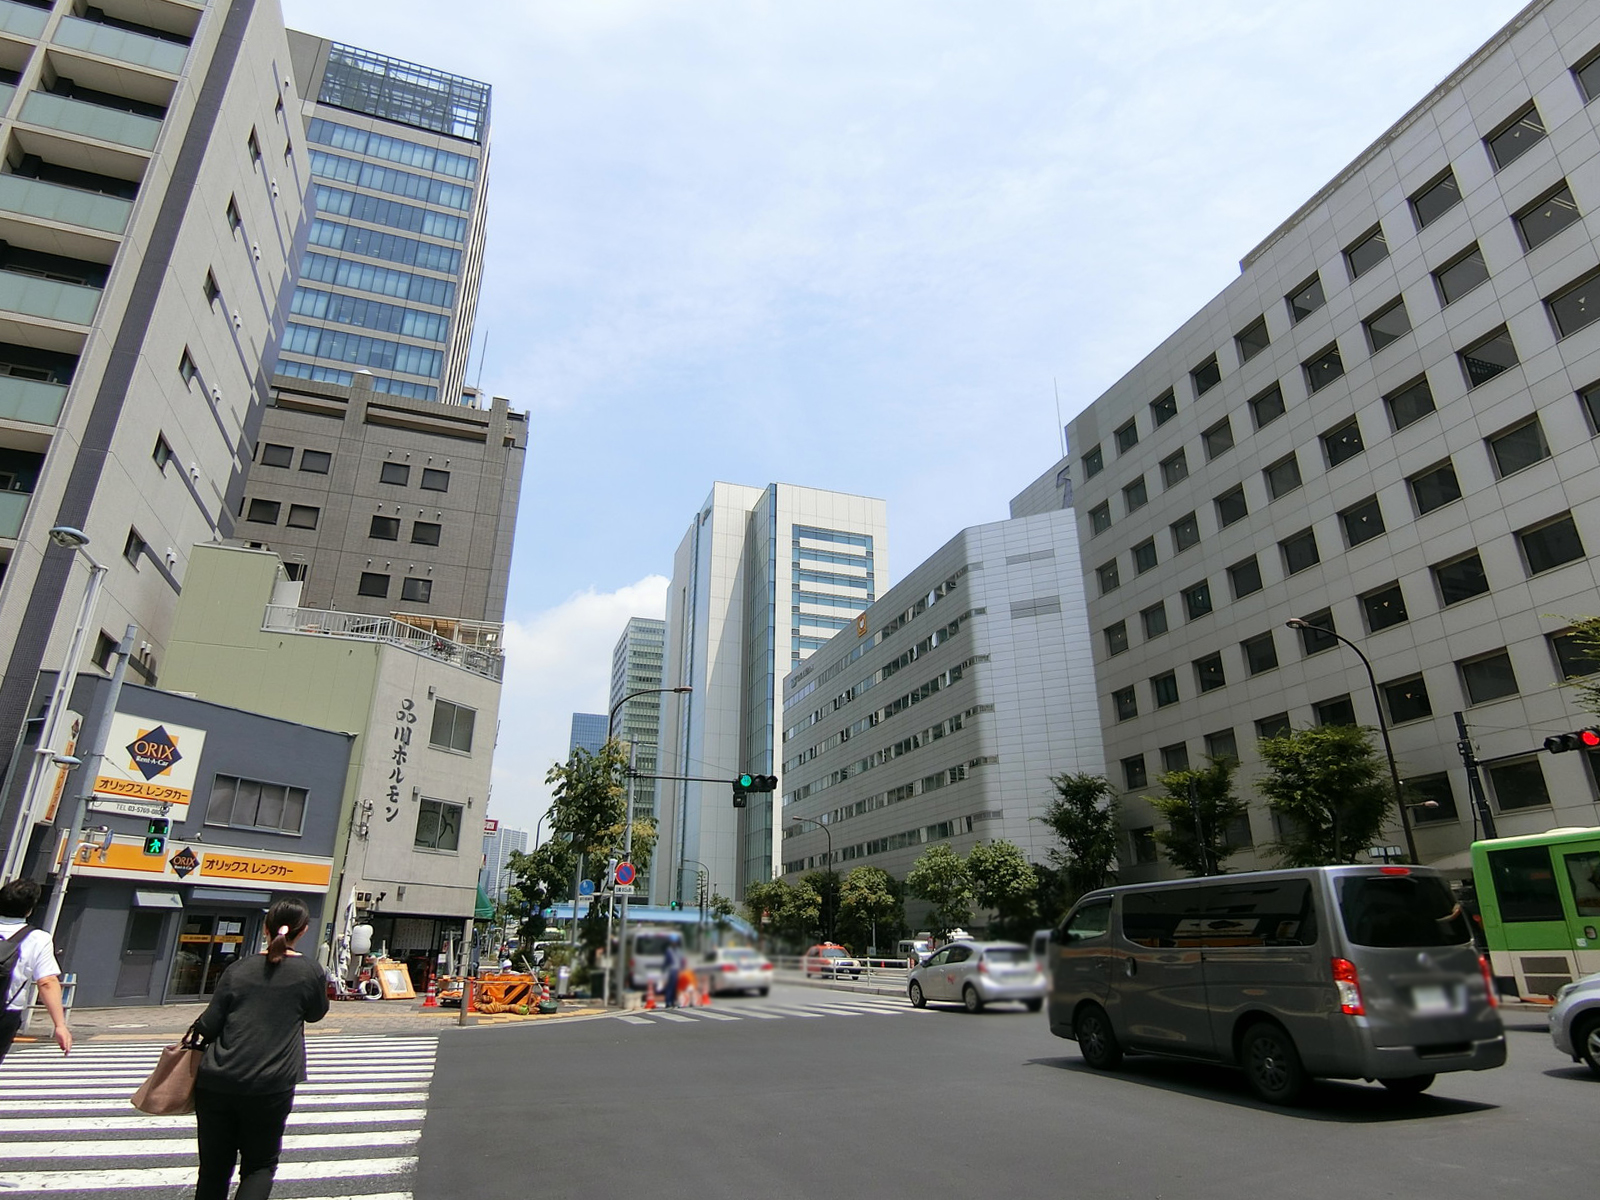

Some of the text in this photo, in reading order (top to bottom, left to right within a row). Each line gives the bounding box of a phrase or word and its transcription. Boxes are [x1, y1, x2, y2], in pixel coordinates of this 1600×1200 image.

[134, 740, 175, 760] ORIX
[135, 755, 170, 767] Rent-A-Car
[385, 698, 417, 823] 品川ホルモン
[98, 779, 188, 800] オリックス レンタカー
[116, 803, 127, 812] TEL
[173, 855, 196, 867] ORIX
[204, 859, 249, 872] オリックス
[251, 863, 294, 877] レンタカー
